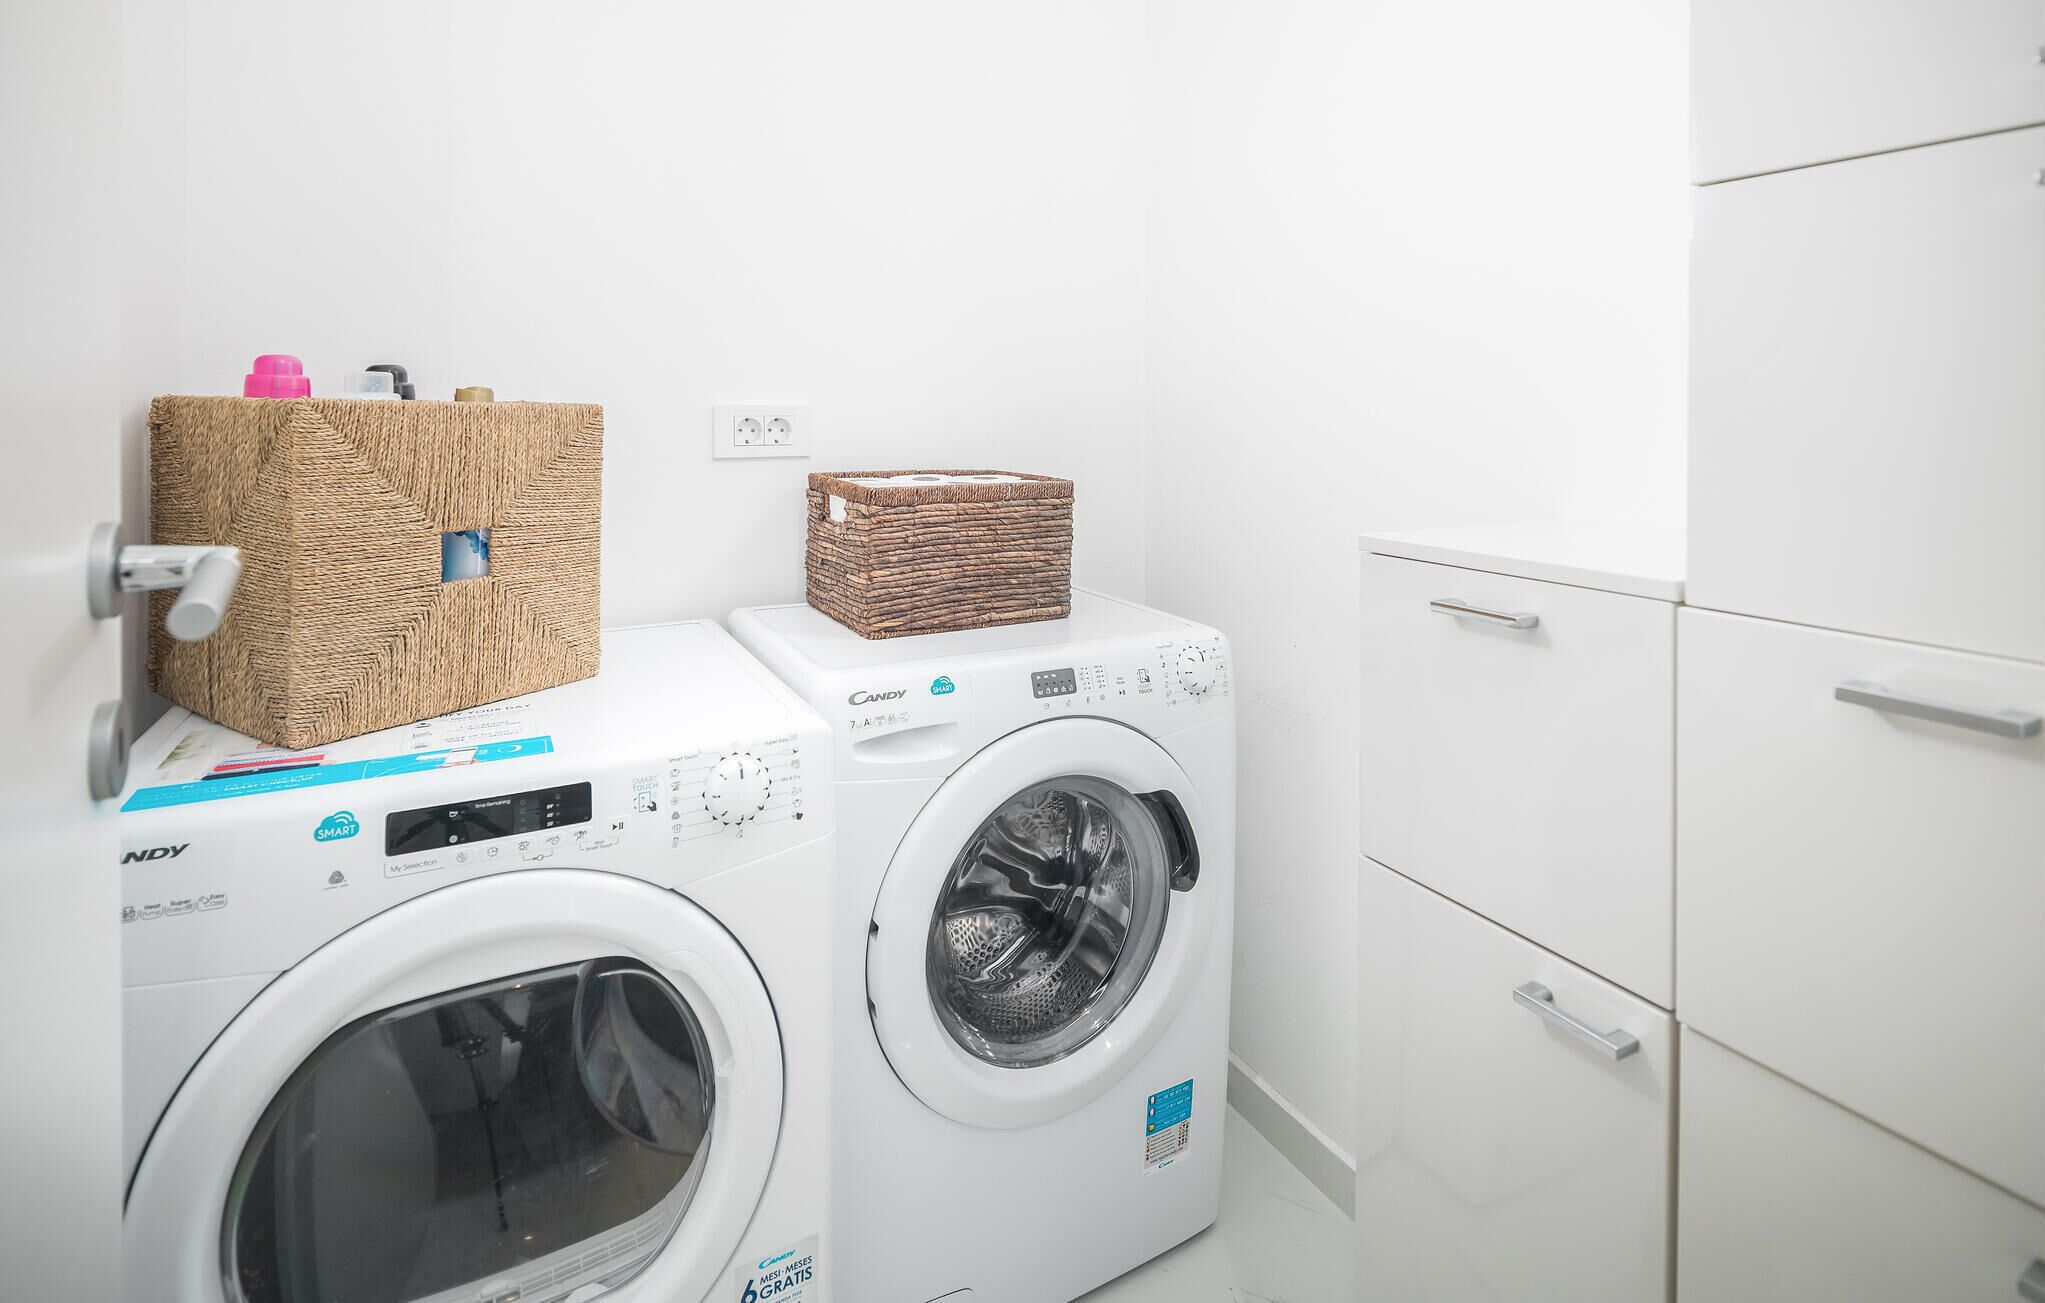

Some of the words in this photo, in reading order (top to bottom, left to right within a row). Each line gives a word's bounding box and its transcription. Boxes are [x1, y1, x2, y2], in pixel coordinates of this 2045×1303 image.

[848, 689, 907, 706] CANDY
[932, 684, 952, 694] SMART
[506, 702, 530, 711] DAY
[632, 782, 659, 792] TOUCH
[317, 823, 356, 840] SMART
[121, 843, 191, 865] NDY
[390, 864, 402, 874] My
[402, 859, 437, 871] Selection
[758, 1249, 797, 1270] CANDY
[760, 1269, 781, 1285] MESI
[785, 1255, 813, 1274] MESES
[740, 1279, 758, 1303] 6
[760, 1266, 813, 1299] GRATIS
